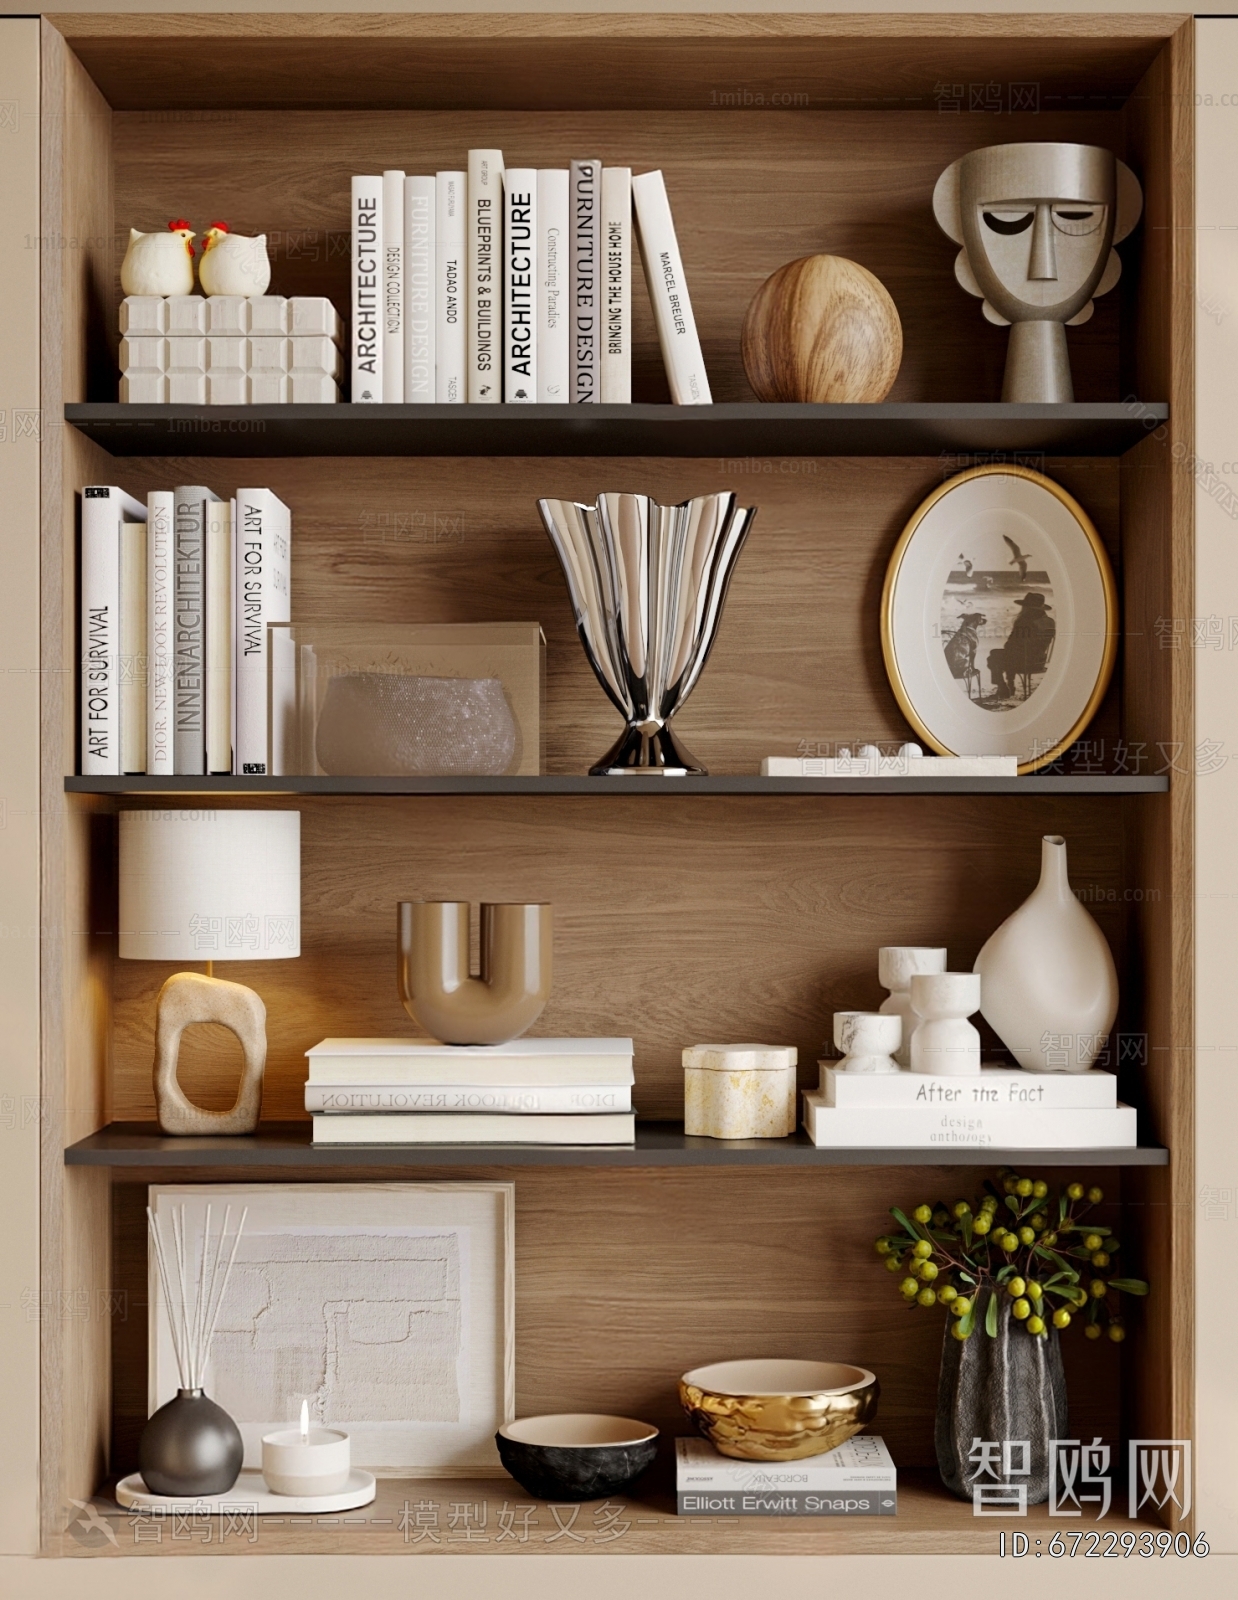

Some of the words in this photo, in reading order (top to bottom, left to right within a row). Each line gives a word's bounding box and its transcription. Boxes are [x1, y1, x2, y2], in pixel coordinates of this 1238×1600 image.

[411, 196, 429, 316] FURNITURE
[477, 199, 491, 283] BLUEPRINTS
[609, 221, 622, 249] HOME
[387, 247, 400, 279] DESIGN
[447, 260, 457, 294] TADAO
[545, 228, 560, 287] Constructing
[609, 251, 622, 283] HOUSE
[358, 197, 377, 374] ARCHITECTURE
[477, 286, 491, 296] &
[511, 192, 531, 376] ARCHITECTURE
[609, 285, 622, 305] THE
[659, 252, 676, 293] MARCEL
[670, 294, 686, 335] BREUER
[386, 281, 400, 334] COLLECTION
[447, 295, 457, 324] ANDO
[547, 290, 560, 329] Paradies
[477, 300, 491, 372] BUILDINGS
[609, 306, 622, 354] BRINGING
[411, 319, 429, 393] DESIGN
[576, 315, 594, 404] DESIGN
[244, 504, 262, 535] ART
[155, 506, 167, 615] REVOLUTION
[244, 542, 262, 575] FOR
[177, 502, 201, 732] INNENARCHITEKTUR
[244, 581, 262, 657] SURVIVAL
[89, 605, 109, 681] SURVIVAL
[155, 621, 167, 667] LOOK
[89, 686, 109, 720] FOR
[155, 675, 167, 711] NEW
[89, 727, 109, 759] ART
[916, 1083, 962, 1103] After
[1008, 1083, 1045, 1103] Fact
[940, 1114, 983, 1130] design
[682, 1496, 736, 1510] Elliott
[742, 1496, 799, 1510] Erwitt
[804, 1495, 870, 1512] Snaps
